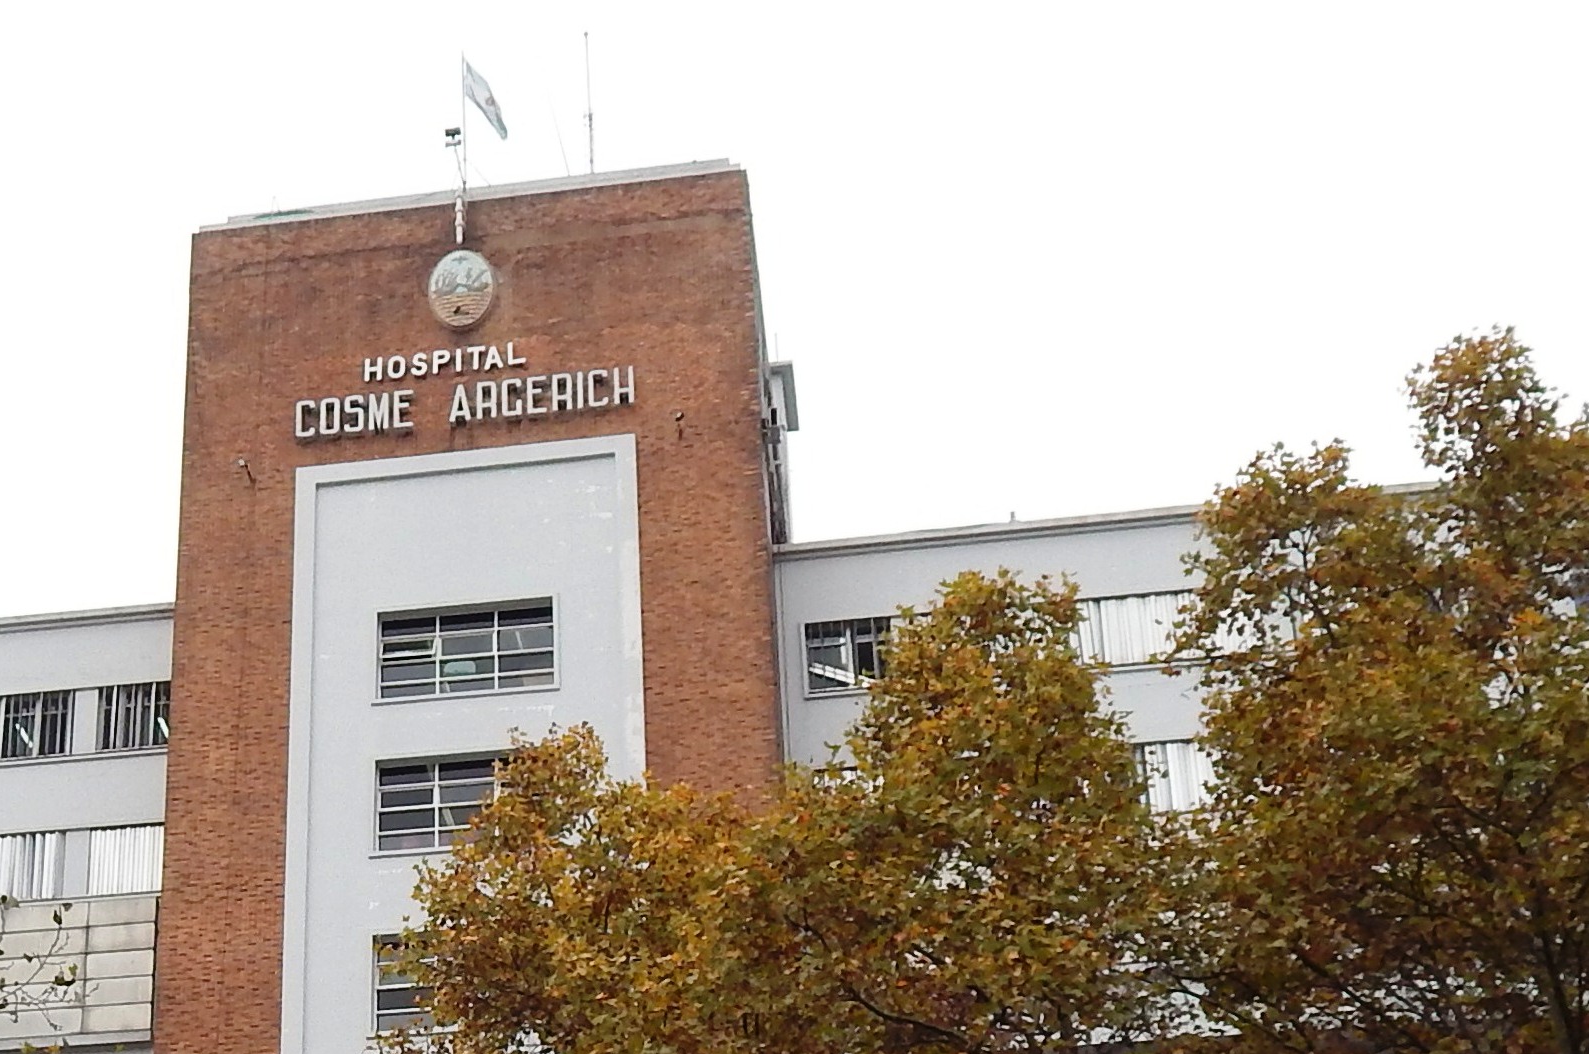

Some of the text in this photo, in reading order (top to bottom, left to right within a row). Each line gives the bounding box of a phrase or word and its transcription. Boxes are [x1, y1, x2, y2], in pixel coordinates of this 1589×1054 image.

[363, 341, 527, 382] HOSPITAL
[295, 364, 636, 438] COSME ARGERICH
